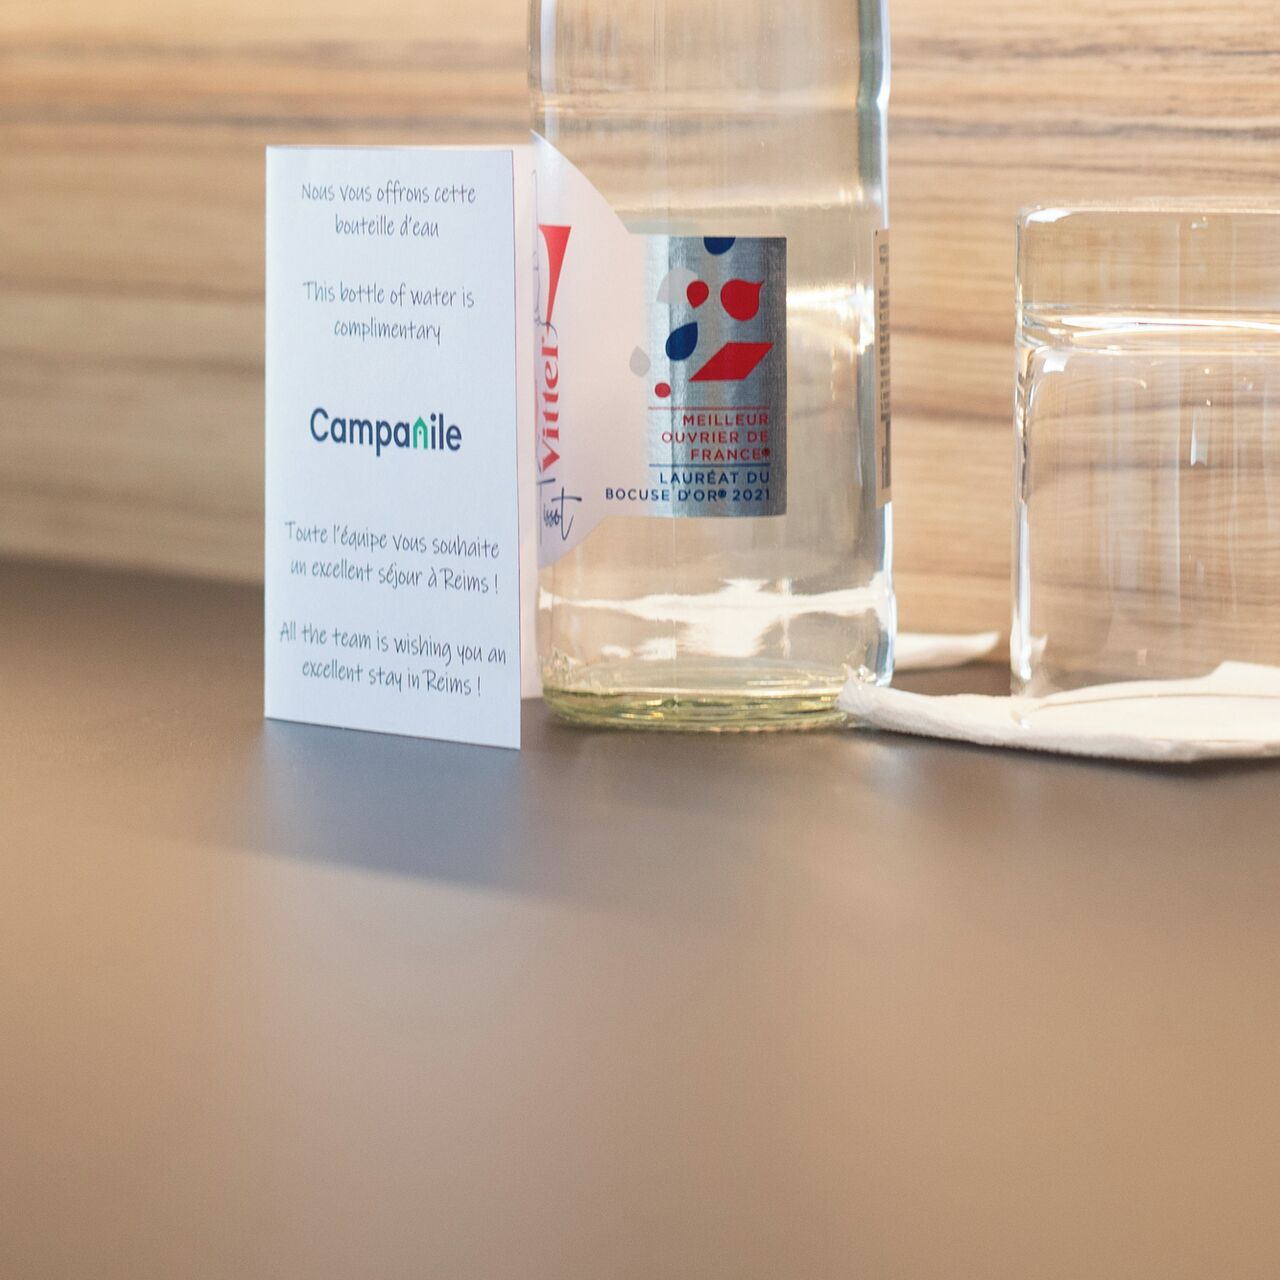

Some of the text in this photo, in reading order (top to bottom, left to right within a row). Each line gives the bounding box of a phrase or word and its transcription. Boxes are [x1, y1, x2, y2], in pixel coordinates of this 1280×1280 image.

[301, 183, 335, 202] Nous
[377, 180, 429, 203] offrons
[434, 183, 476, 204] cette
[335, 214, 395, 236] bouteille
[302, 281, 474, 308] This bottle of water is
[334, 317, 441, 345] complimentary
[310, 407, 462, 457] Campanile
[683, 414, 769, 426] MEILLEUR
[662, 431, 769, 443] OUVRIER DE
[660, 470, 770, 484] LAURÉAT DU
[606, 488, 670, 501] BOCUSE
[732, 489, 770, 501] 2021
[284, 521, 328, 544] Toute
[432, 535, 499, 559] souhaite
[291, 561, 306, 576] un
[312, 559, 372, 582] excellent
[378, 562, 421, 589] séjour
[428, 567, 438, 587] à
[440, 568, 489, 594] Reims
[280, 621, 506, 666] All the team is wishing you an
[302, 660, 363, 682] excellent
[369, 668, 402, 692] stay
[408, 668, 420, 690] in
[422, 669, 471, 696] Reims
